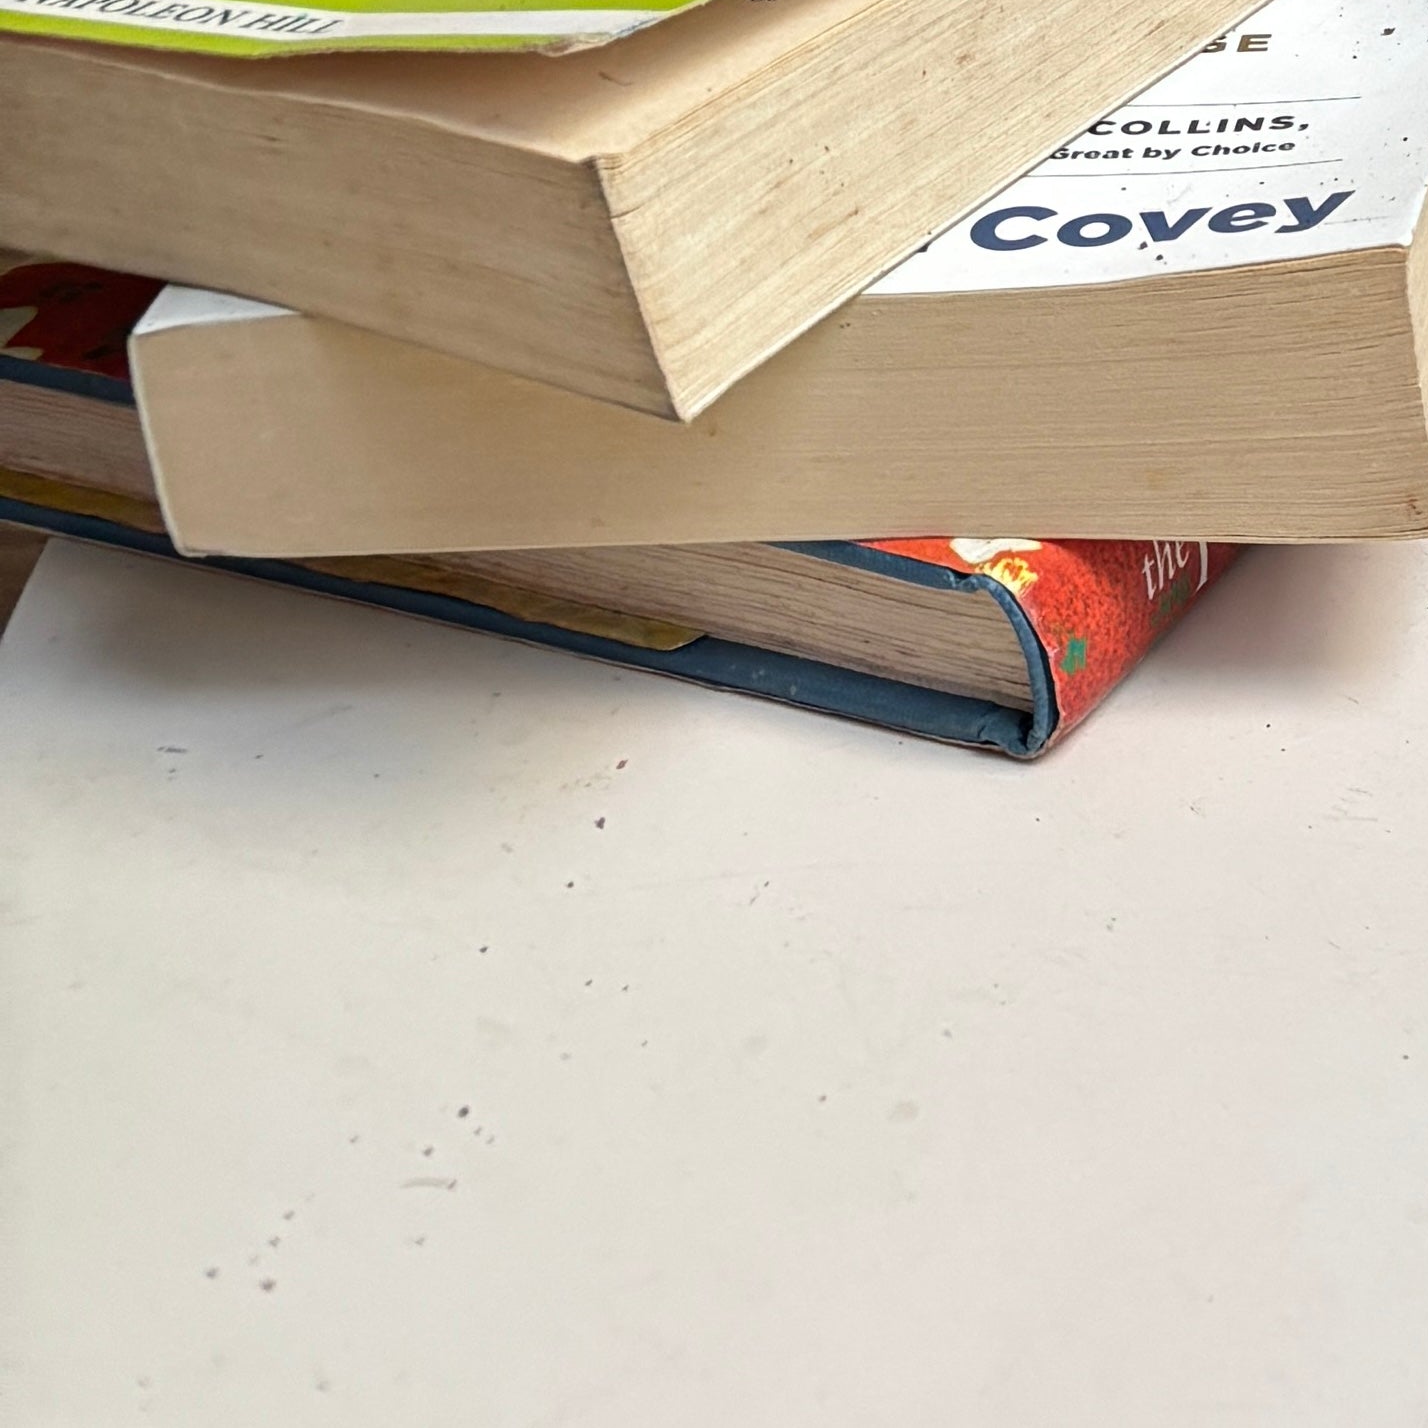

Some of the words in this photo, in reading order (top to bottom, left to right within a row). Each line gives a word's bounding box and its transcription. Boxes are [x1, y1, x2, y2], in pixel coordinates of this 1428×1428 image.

[238, 13, 345, 34] HILL
[1050, 146, 1134, 160] Great
[1142, 147, 1182, 160] by
[1191, 141, 1296, 158] Choice
[970, 190, 1356, 252] Covey
[1141, 540, 1190, 601] the
